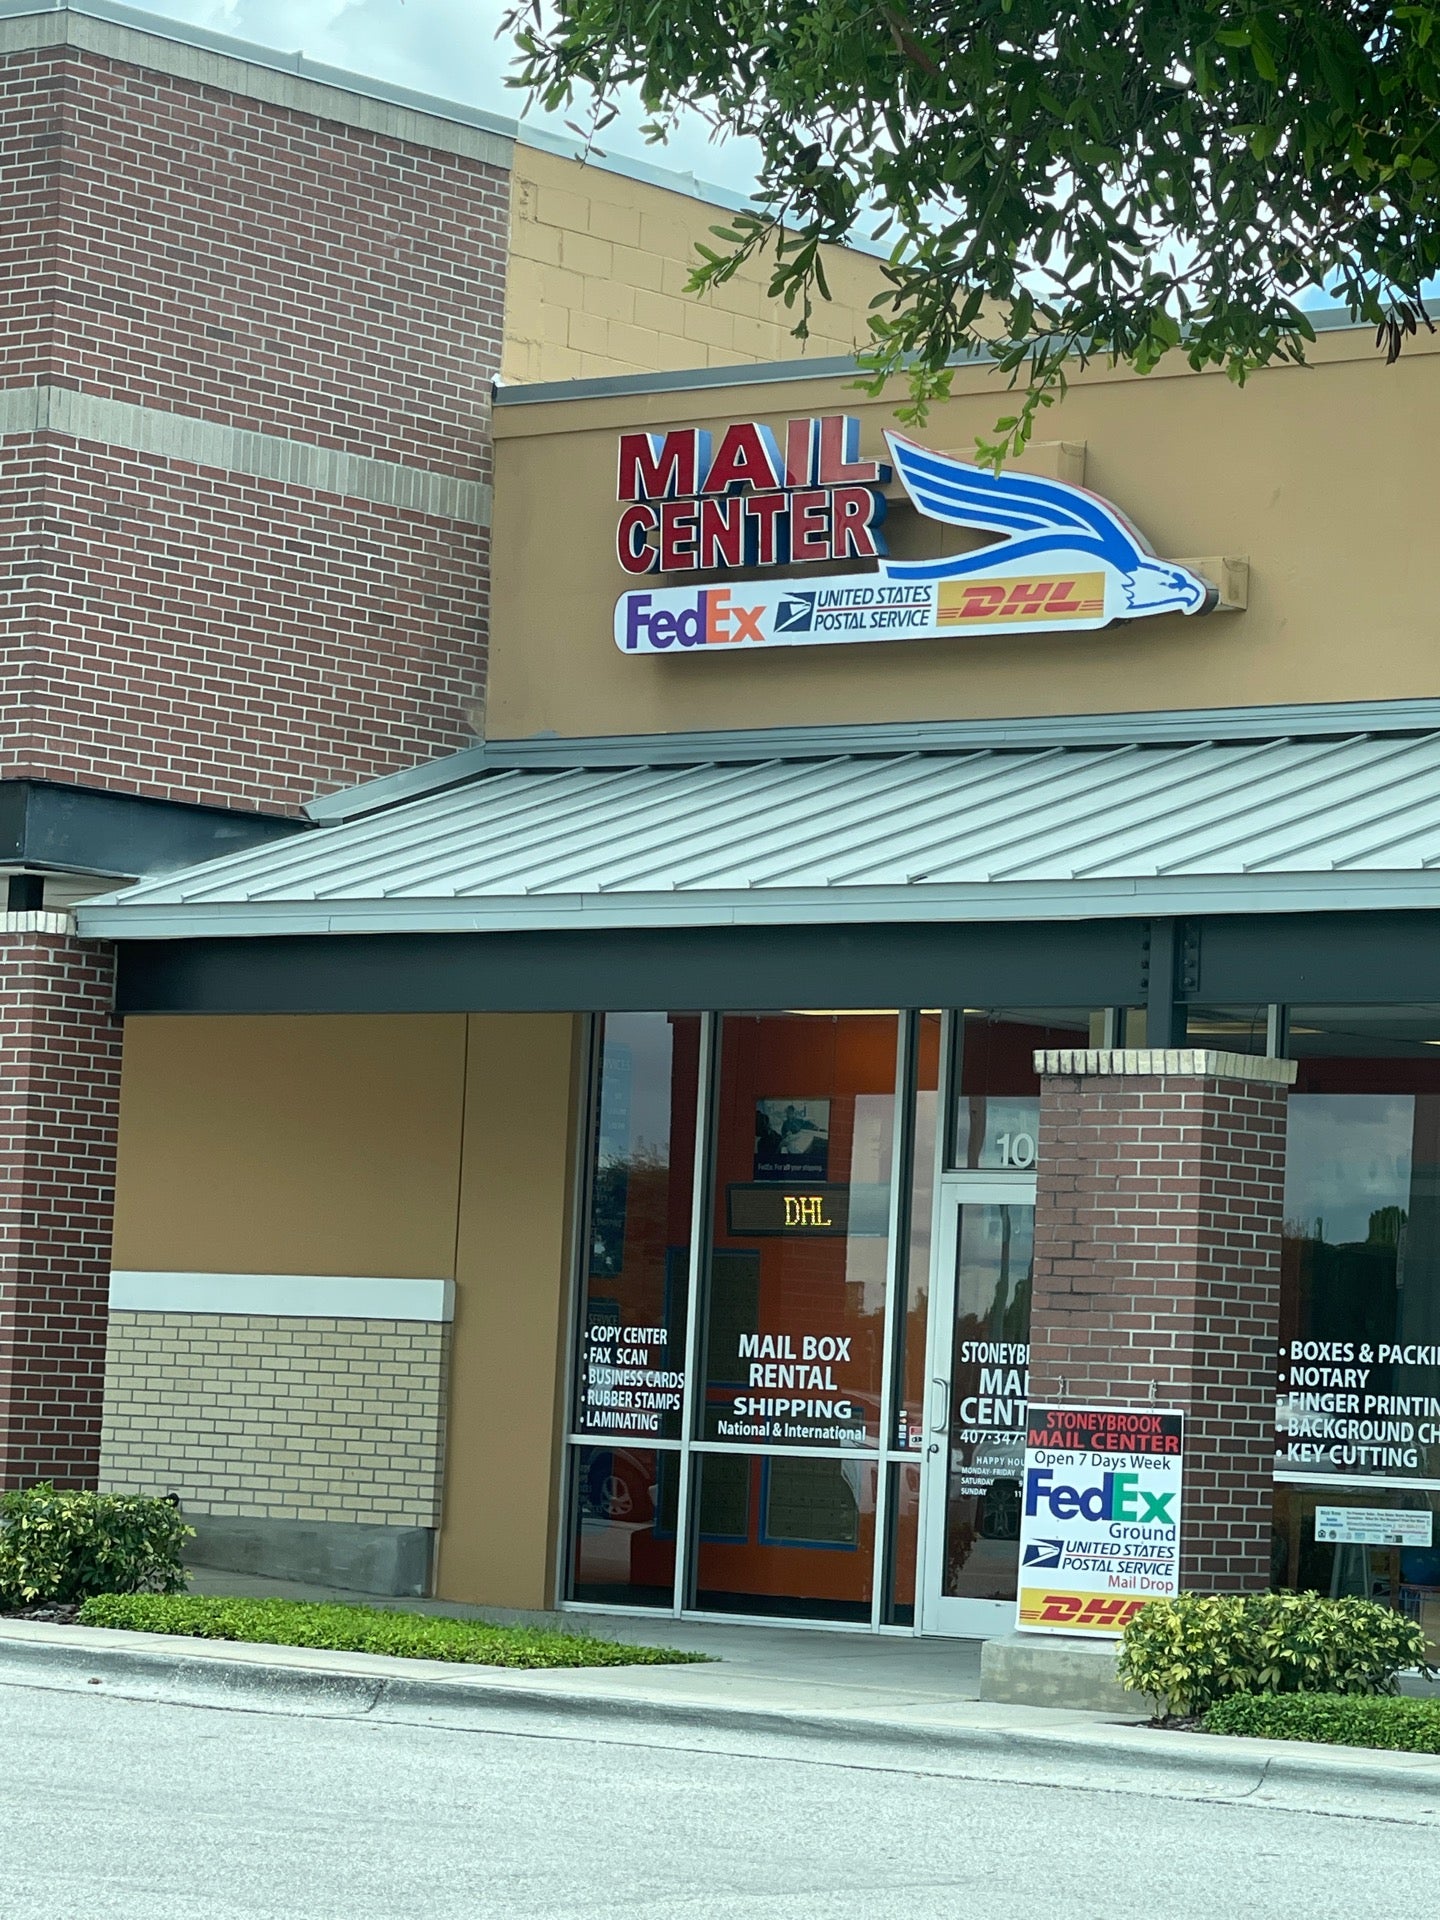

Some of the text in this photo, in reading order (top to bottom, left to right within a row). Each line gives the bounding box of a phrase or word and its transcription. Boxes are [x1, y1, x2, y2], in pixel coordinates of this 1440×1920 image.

[617, 414, 884, 501] MAIL
[616, 486, 882, 575] CENTER
[817, 585, 932, 607] UNITED STATES
[958, 581, 1082, 618] DHL
[626, 588, 767, 649] FedEx
[814, 609, 931, 631] POSTAL SERVICE
[997, 1133, 1035, 1168] 10
[784, 1196, 832, 1226] DHL
[590, 1325, 668, 1345] COPY CENTER
[589, 1347, 648, 1366] FAX SCAN
[738, 1333, 852, 1362] MAIL BOX
[1290, 1340, 1354, 1363] BOXES
[1358, 1343, 1374, 1363] &
[588, 1368, 685, 1389] BUSINESS CARDS
[749, 1363, 838, 1391] RENTAL
[1289, 1366, 1370, 1389] NOTARY
[587, 1389, 681, 1411] RUBBER STAMPS
[733, 1396, 852, 1419] SHIPPING
[1288, 1391, 1360, 1414] FINGER
[586, 1410, 659, 1431] LAMINATING
[960, 1396, 1028, 1427] CENT
[1046, 1412, 1162, 1432] STONEYBROOK
[717, 1420, 866, 1441] National & International
[1028, 1429, 1179, 1453] MAIL CENTER
[1287, 1417, 1414, 1443] BACKGROUND
[976, 1456, 1005, 1466] HAPPY
[1034, 1451, 1171, 1472] Open 7 Days Week
[1287, 1442, 1418, 1468] KEY CUTTING
[961, 1477, 995, 1486] SATURDAY
[961, 1488, 987, 1496] SUNDAY
[1025, 1468, 1176, 1525] FedEx
[1109, 1523, 1176, 1542] Ground
[1066, 1540, 1175, 1559] UNITED STATES
[1062, 1557, 1175, 1576] POSTAL SERVICE
[1108, 1575, 1174, 1594] Mail Drop
